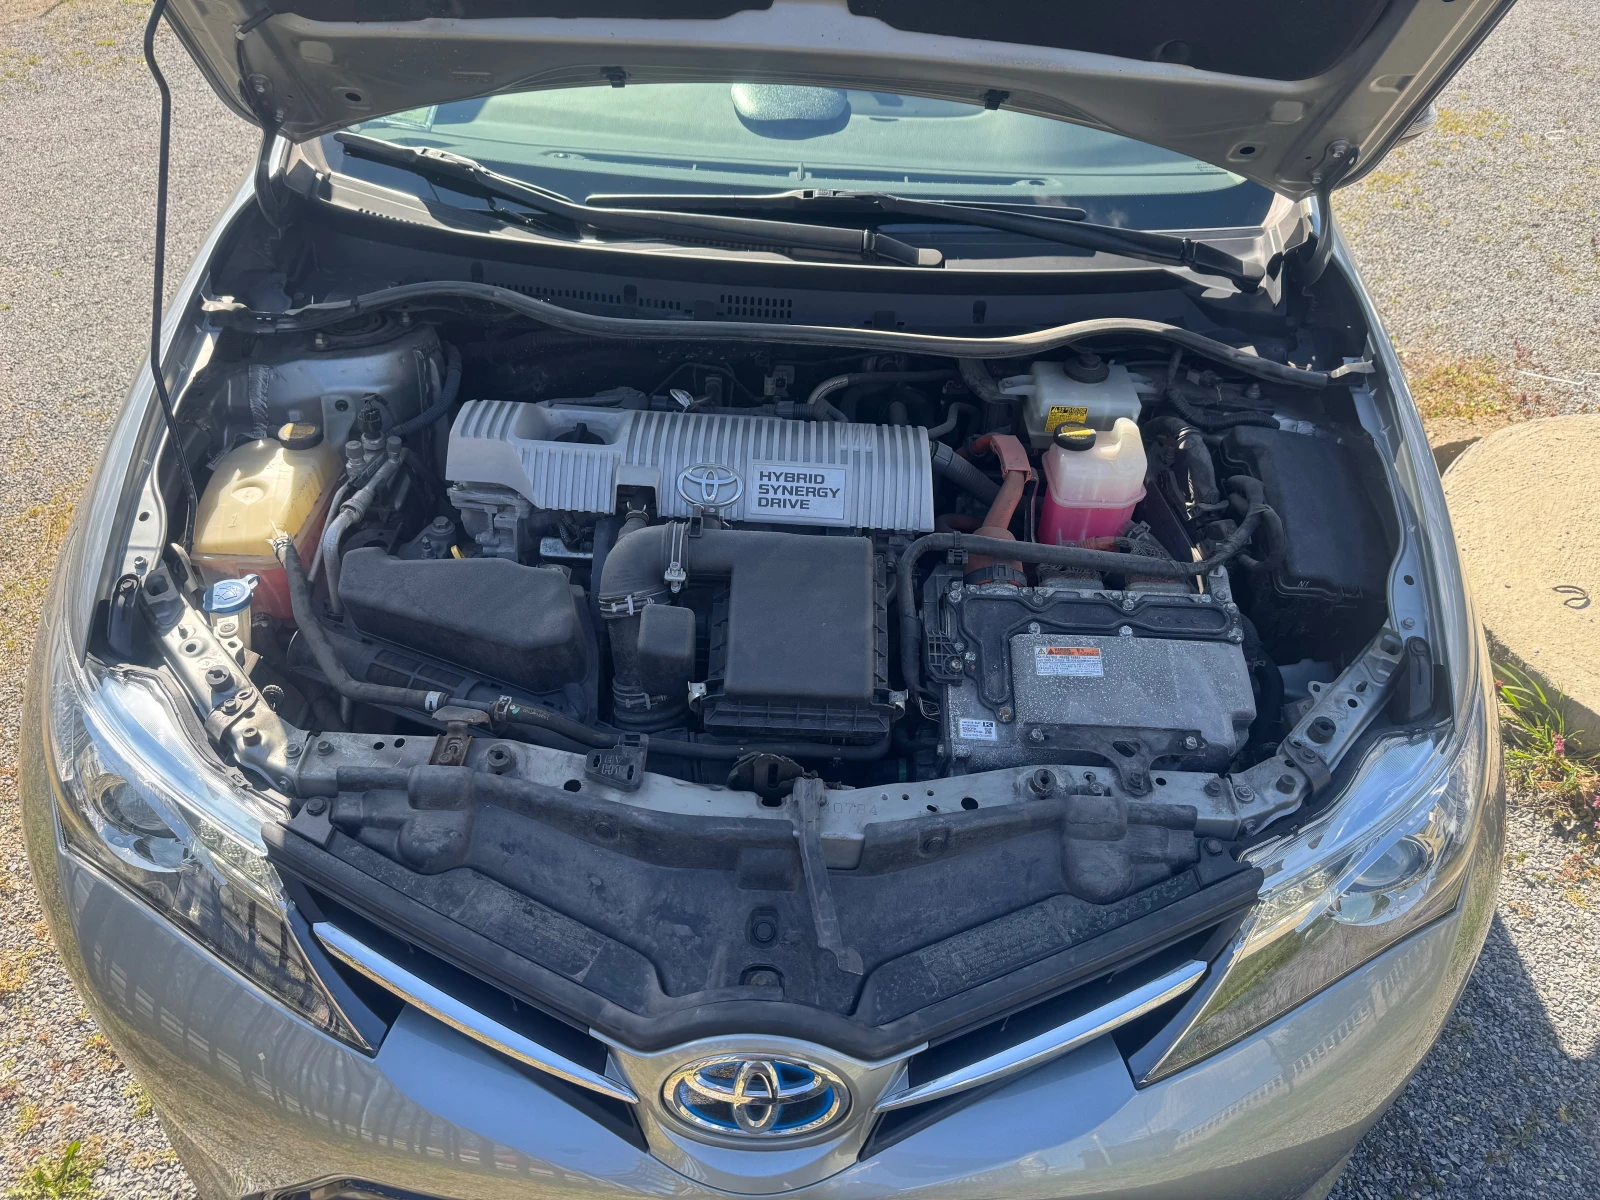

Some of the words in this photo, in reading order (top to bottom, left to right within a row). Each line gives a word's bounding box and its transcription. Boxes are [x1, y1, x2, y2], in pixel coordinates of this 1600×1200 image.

[759, 471, 826, 485] HYBRID
[758, 484, 841, 499] SYNERGY
[757, 497, 811, 510] DRIVE
